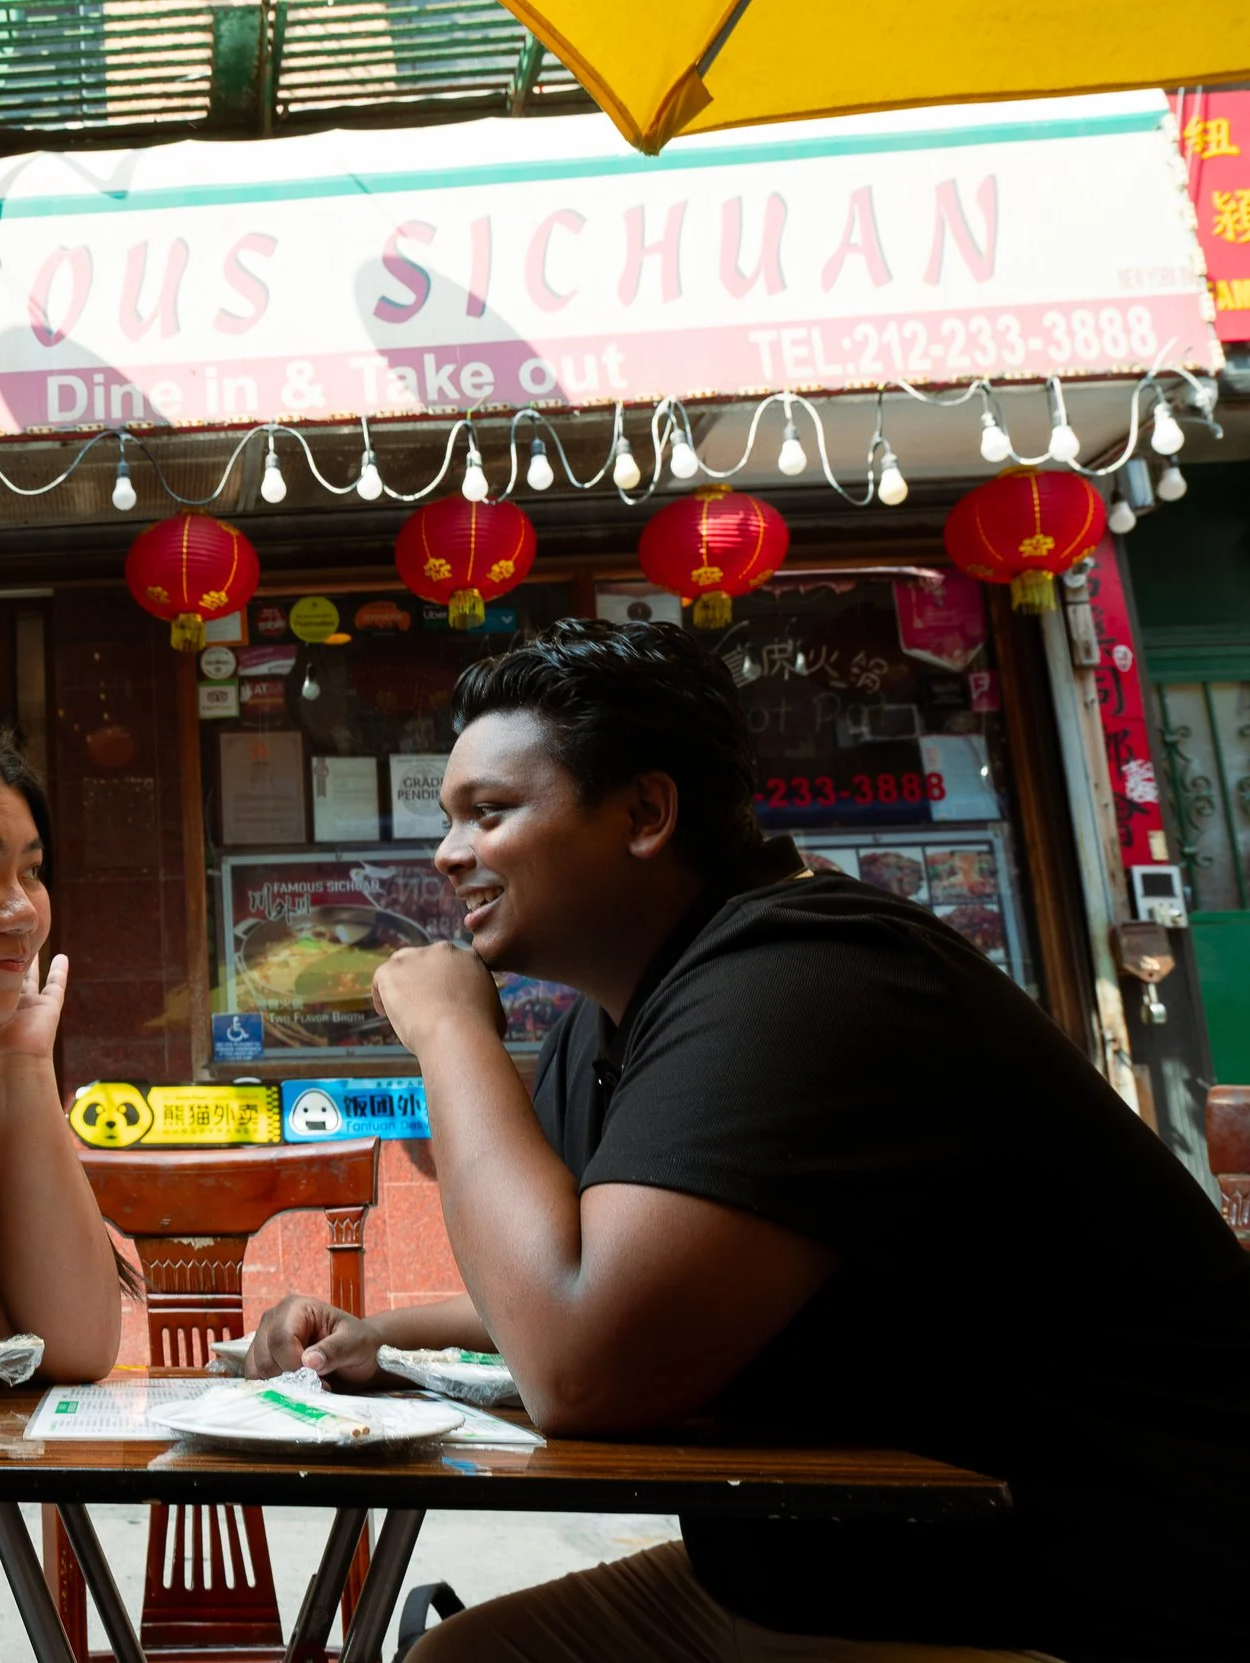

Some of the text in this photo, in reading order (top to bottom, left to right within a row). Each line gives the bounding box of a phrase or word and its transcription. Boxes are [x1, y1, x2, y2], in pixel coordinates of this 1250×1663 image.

[373, 174, 999, 325] SICHUAN
[751, 304, 1155, 381] TEL:212-233-3888
[46, 342, 626, 424] Dine in & Take out
[746, 696, 794, 736] ot
[397, 789, 440, 801] PENDI
[754, 771, 947, 808] -233-3888
[272, 881, 324, 895] FAMOUS
[163, 1103, 259, 1126] 熊猫外卖
[343, 1094, 428, 1117] 饭团外
